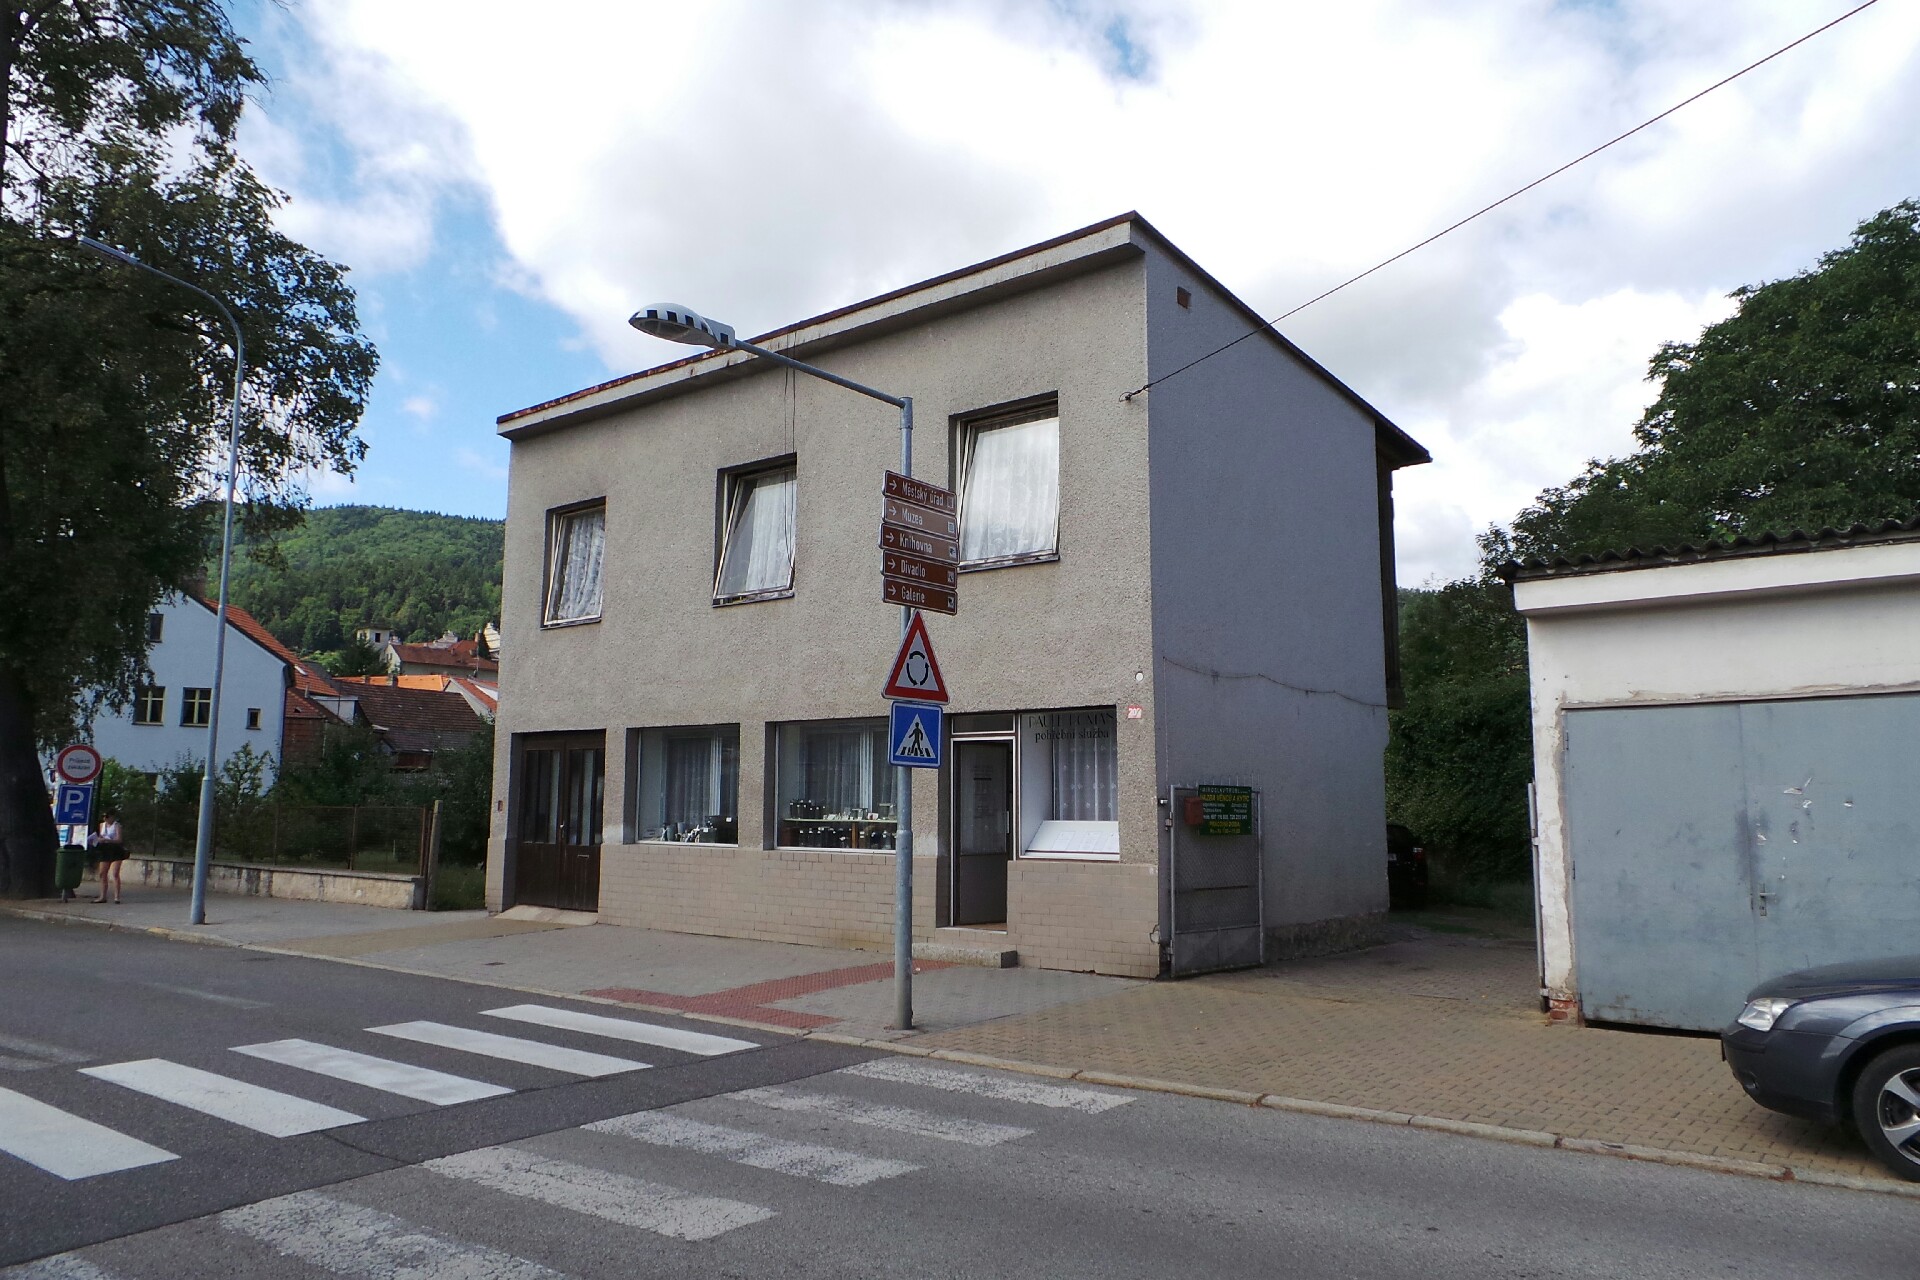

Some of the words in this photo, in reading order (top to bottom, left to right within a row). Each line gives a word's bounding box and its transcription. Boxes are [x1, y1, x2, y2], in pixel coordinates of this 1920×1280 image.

[901, 507, 923, 525] Muzea
[899, 532, 933, 553] Knihovna
[900, 559, 926, 577] Divadlo
[901, 585, 925, 603] Galerie
[1035, 728, 1075, 744] pohřební
[1078, 727, 1110, 739] služba
[64, 789, 85, 813] P
